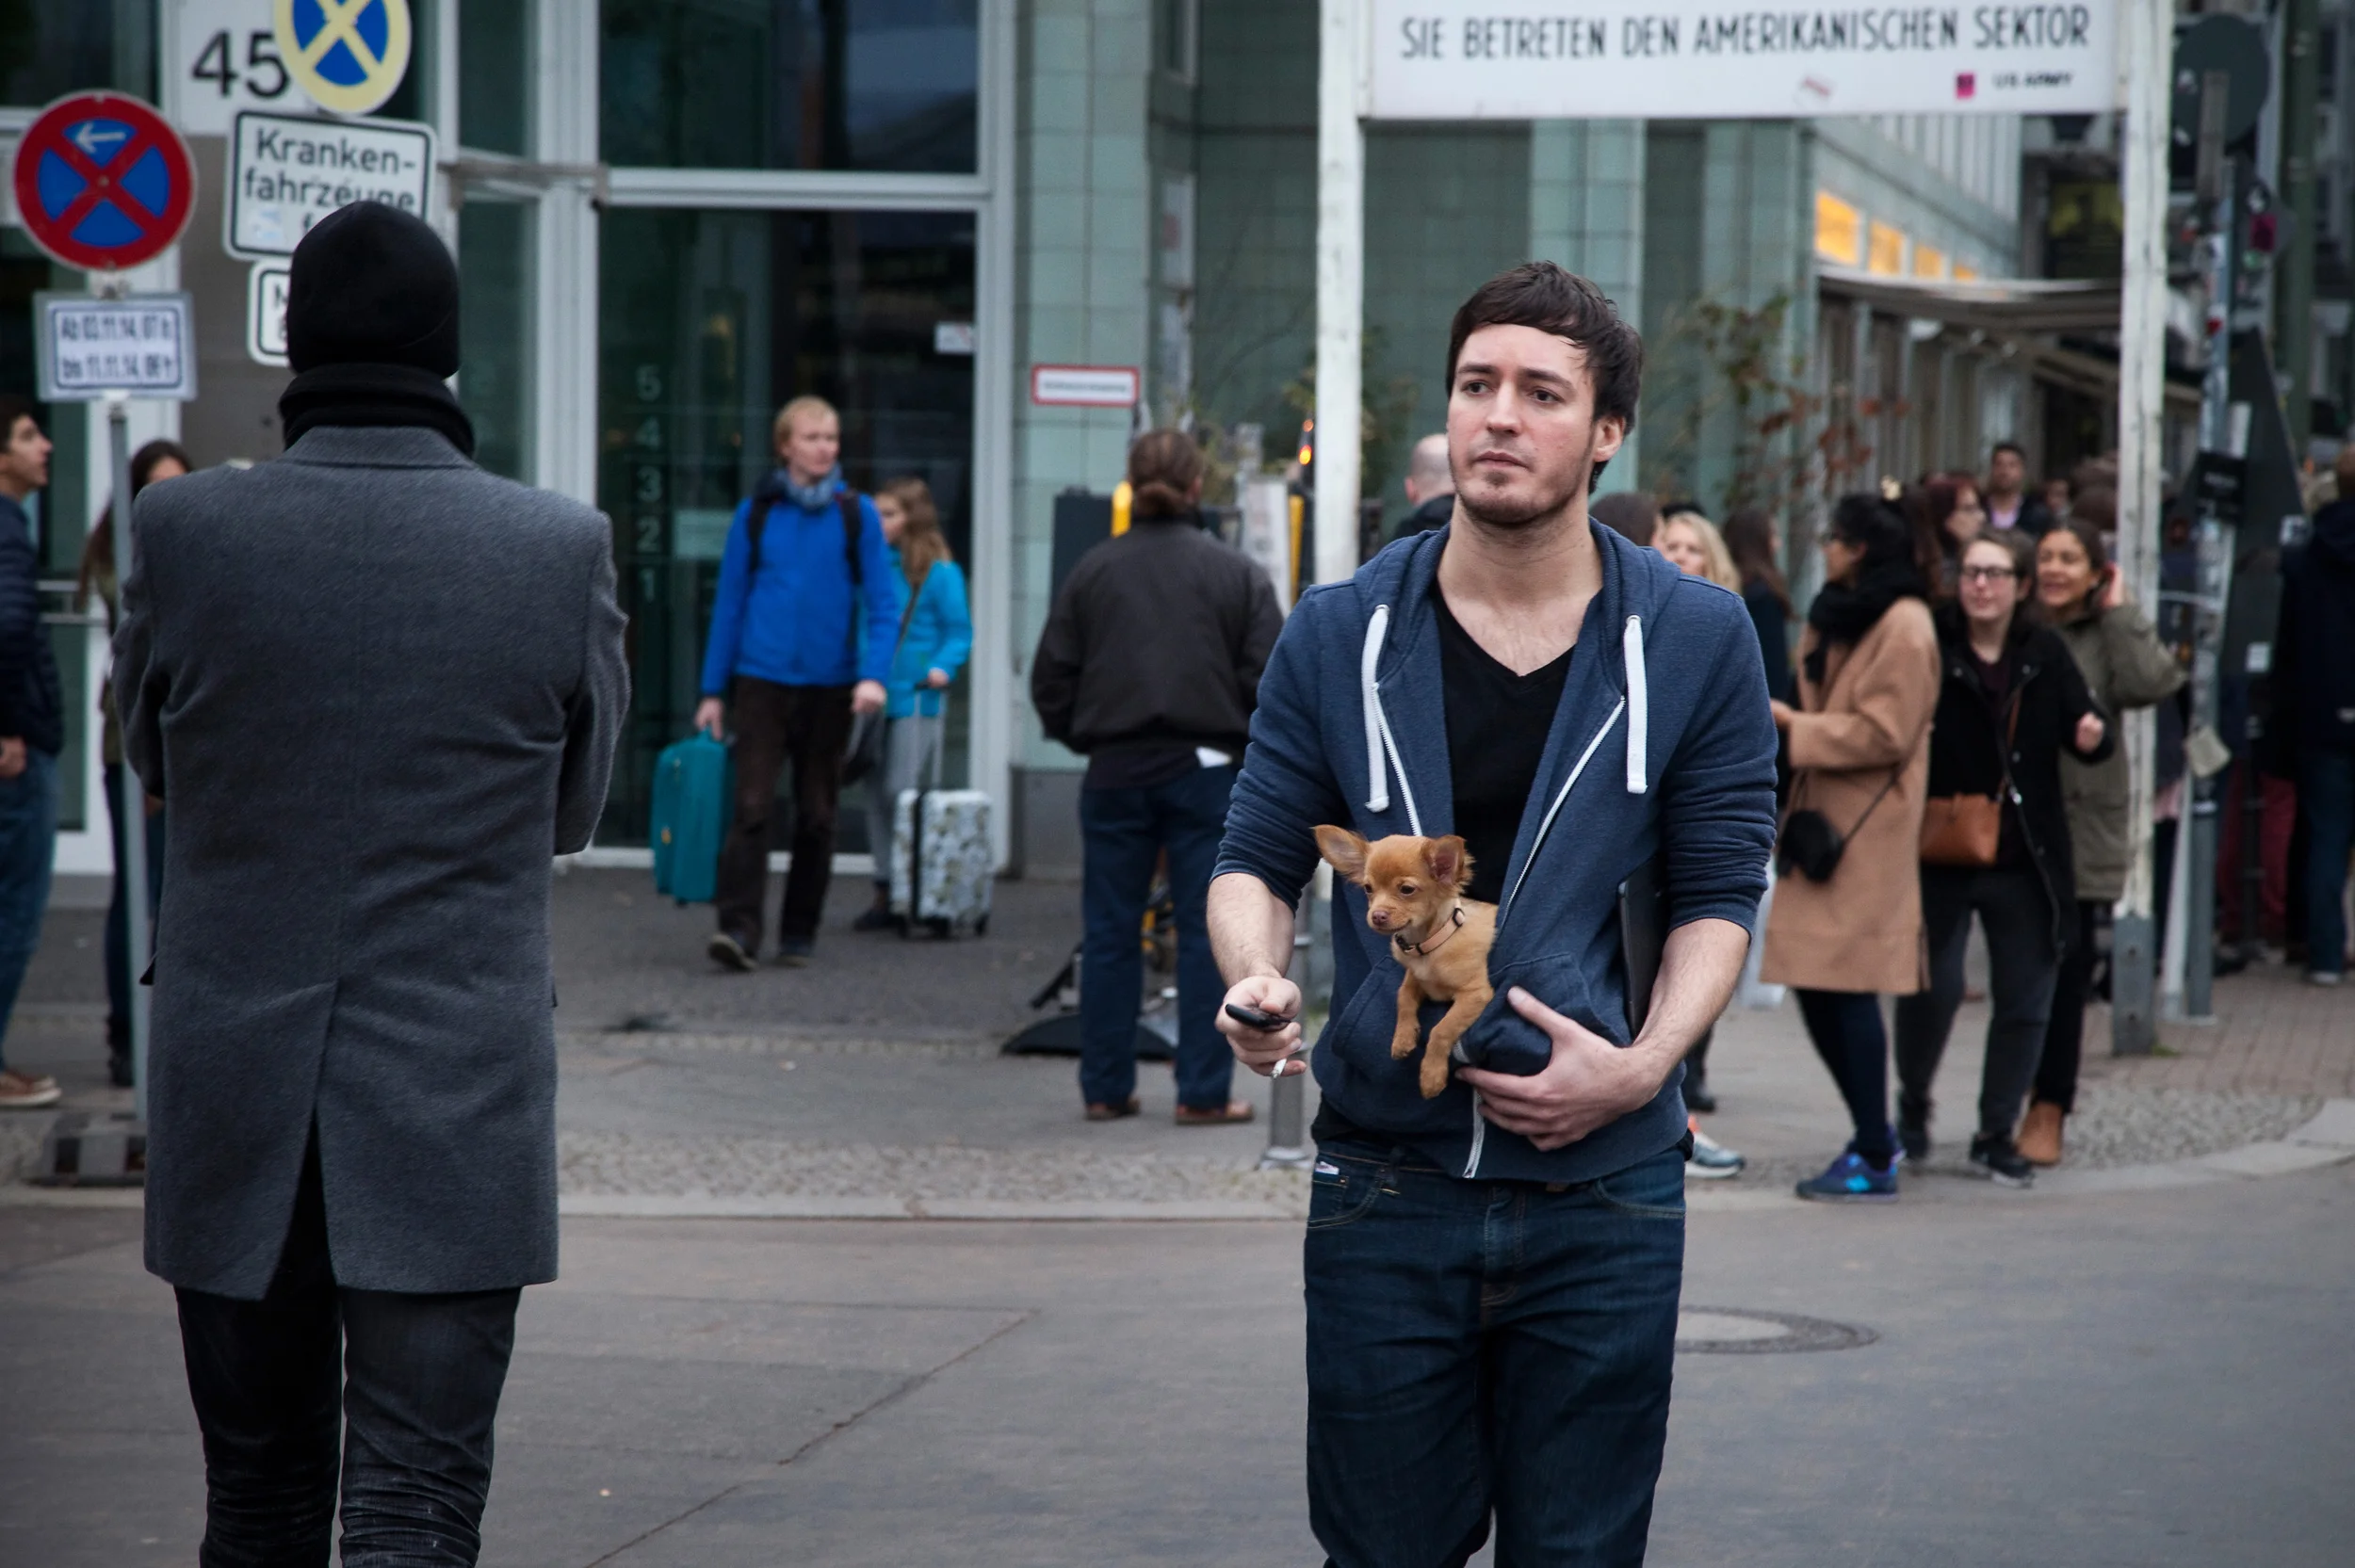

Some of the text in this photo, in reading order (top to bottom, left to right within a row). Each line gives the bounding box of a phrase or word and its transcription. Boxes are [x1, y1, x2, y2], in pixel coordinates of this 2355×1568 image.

[1401, 5, 2090, 59] SIE BETRETEN DEN AMERIKANISCHEN SEKTOR
[191, 29, 291, 100] 45
[255, 127, 415, 174] Kranken-
